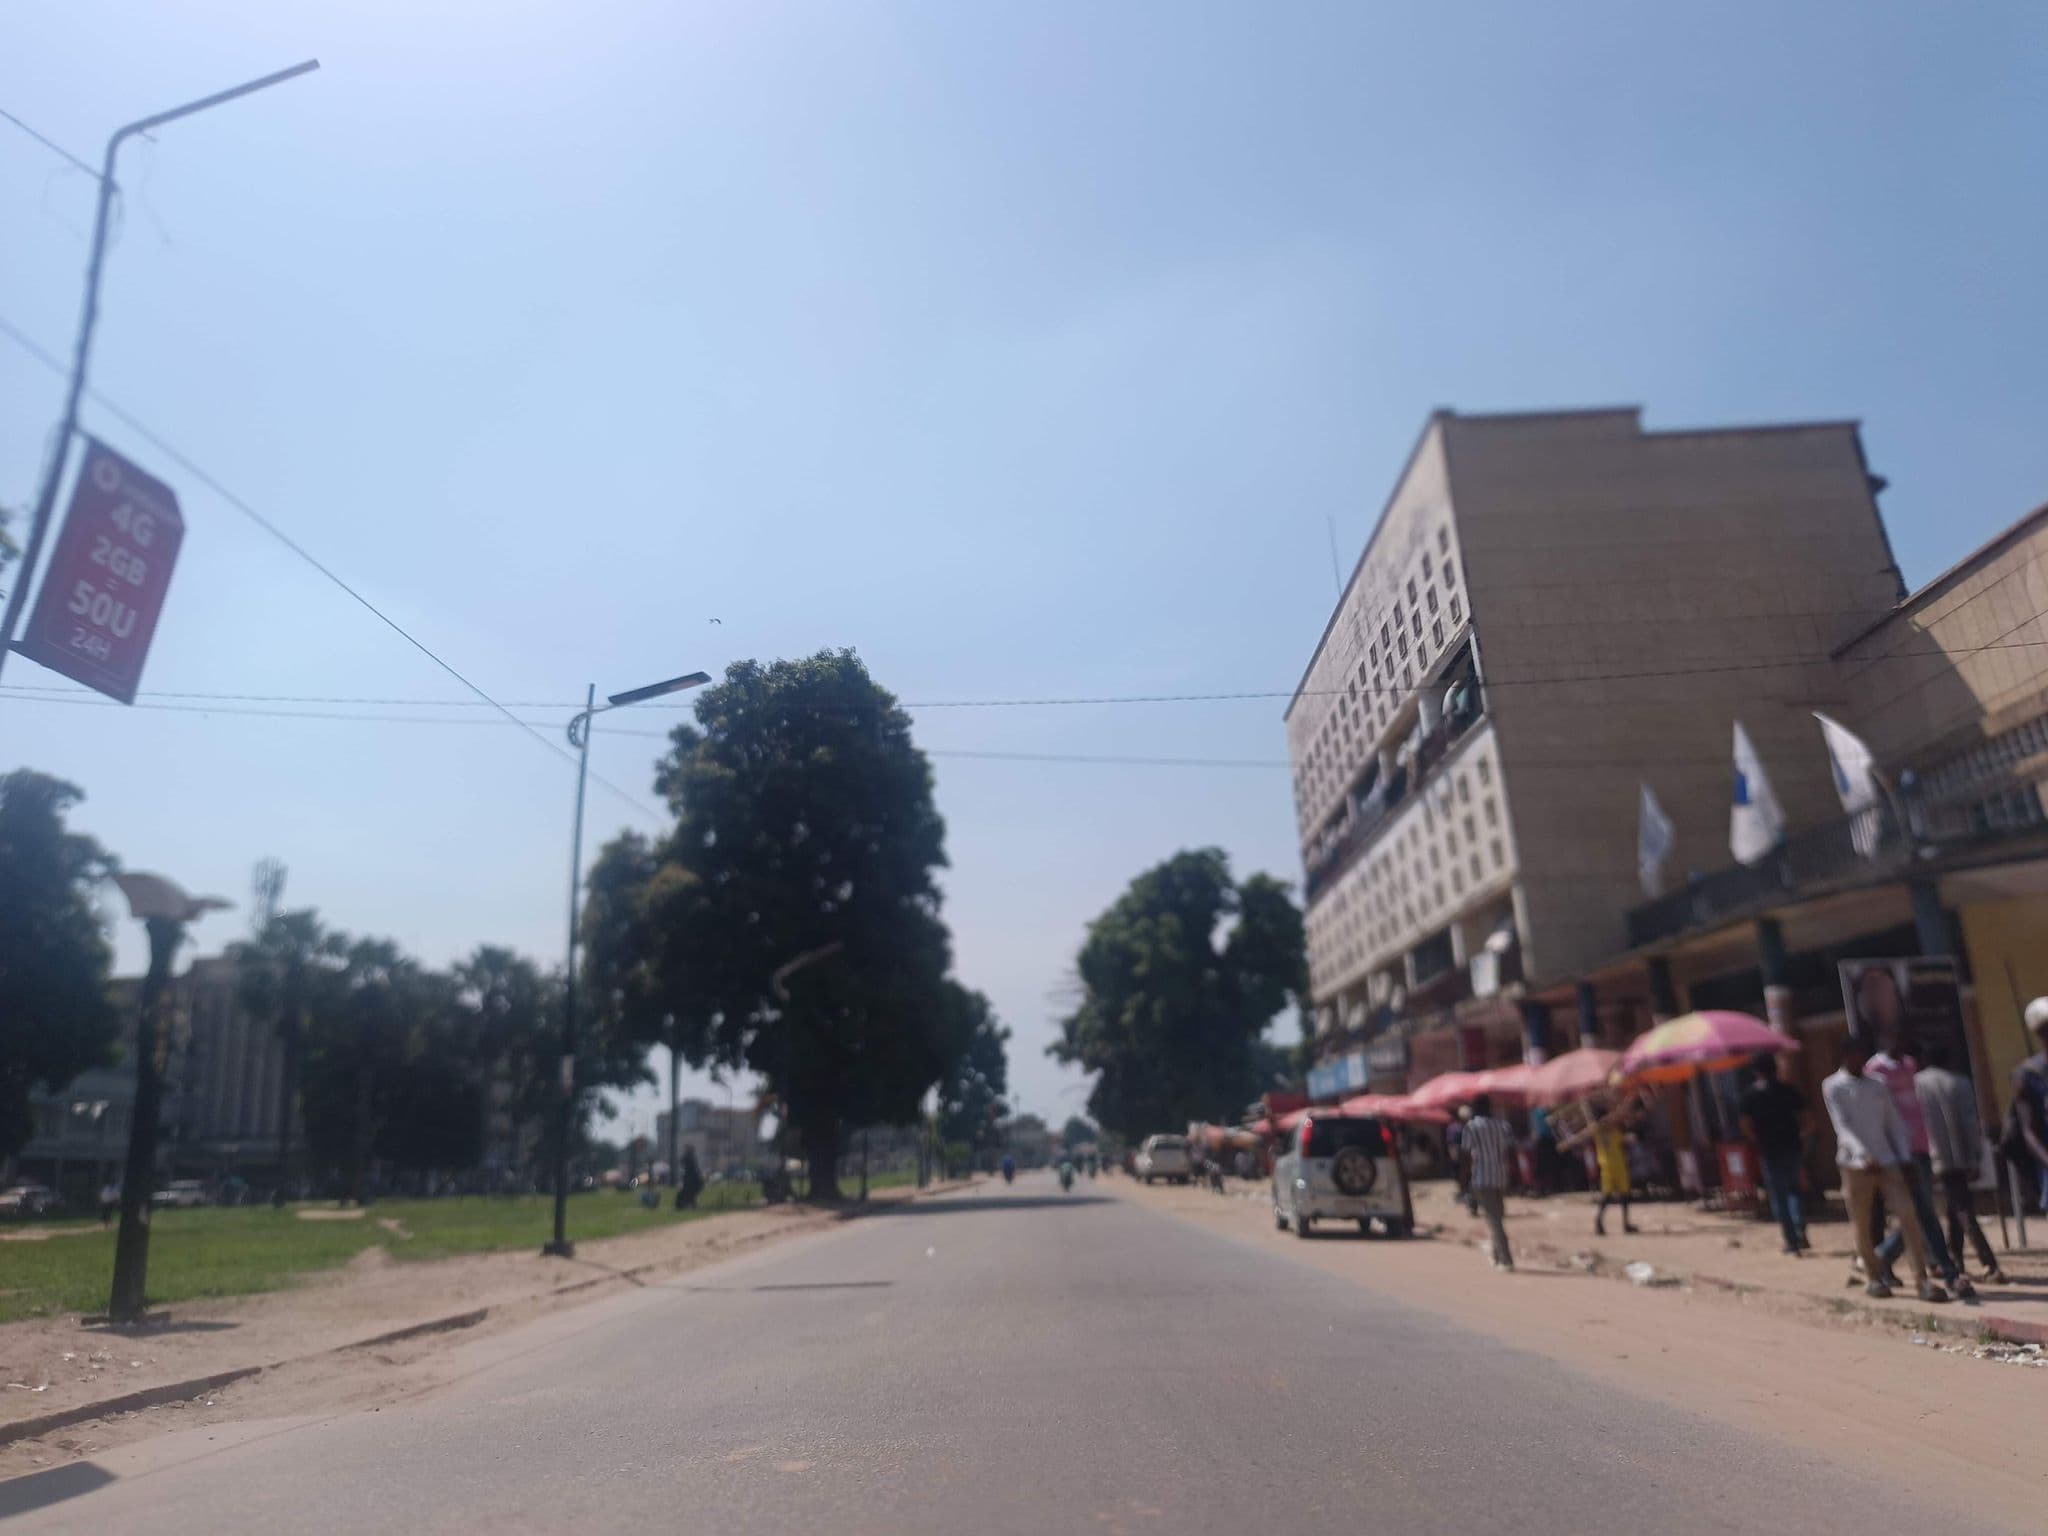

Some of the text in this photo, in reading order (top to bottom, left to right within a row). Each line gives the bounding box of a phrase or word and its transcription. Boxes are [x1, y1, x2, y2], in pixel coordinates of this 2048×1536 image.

[111, 503, 155, 547] 4G
[91, 536, 147, 587] 2GB
[68, 580, 136, 638] 50U
